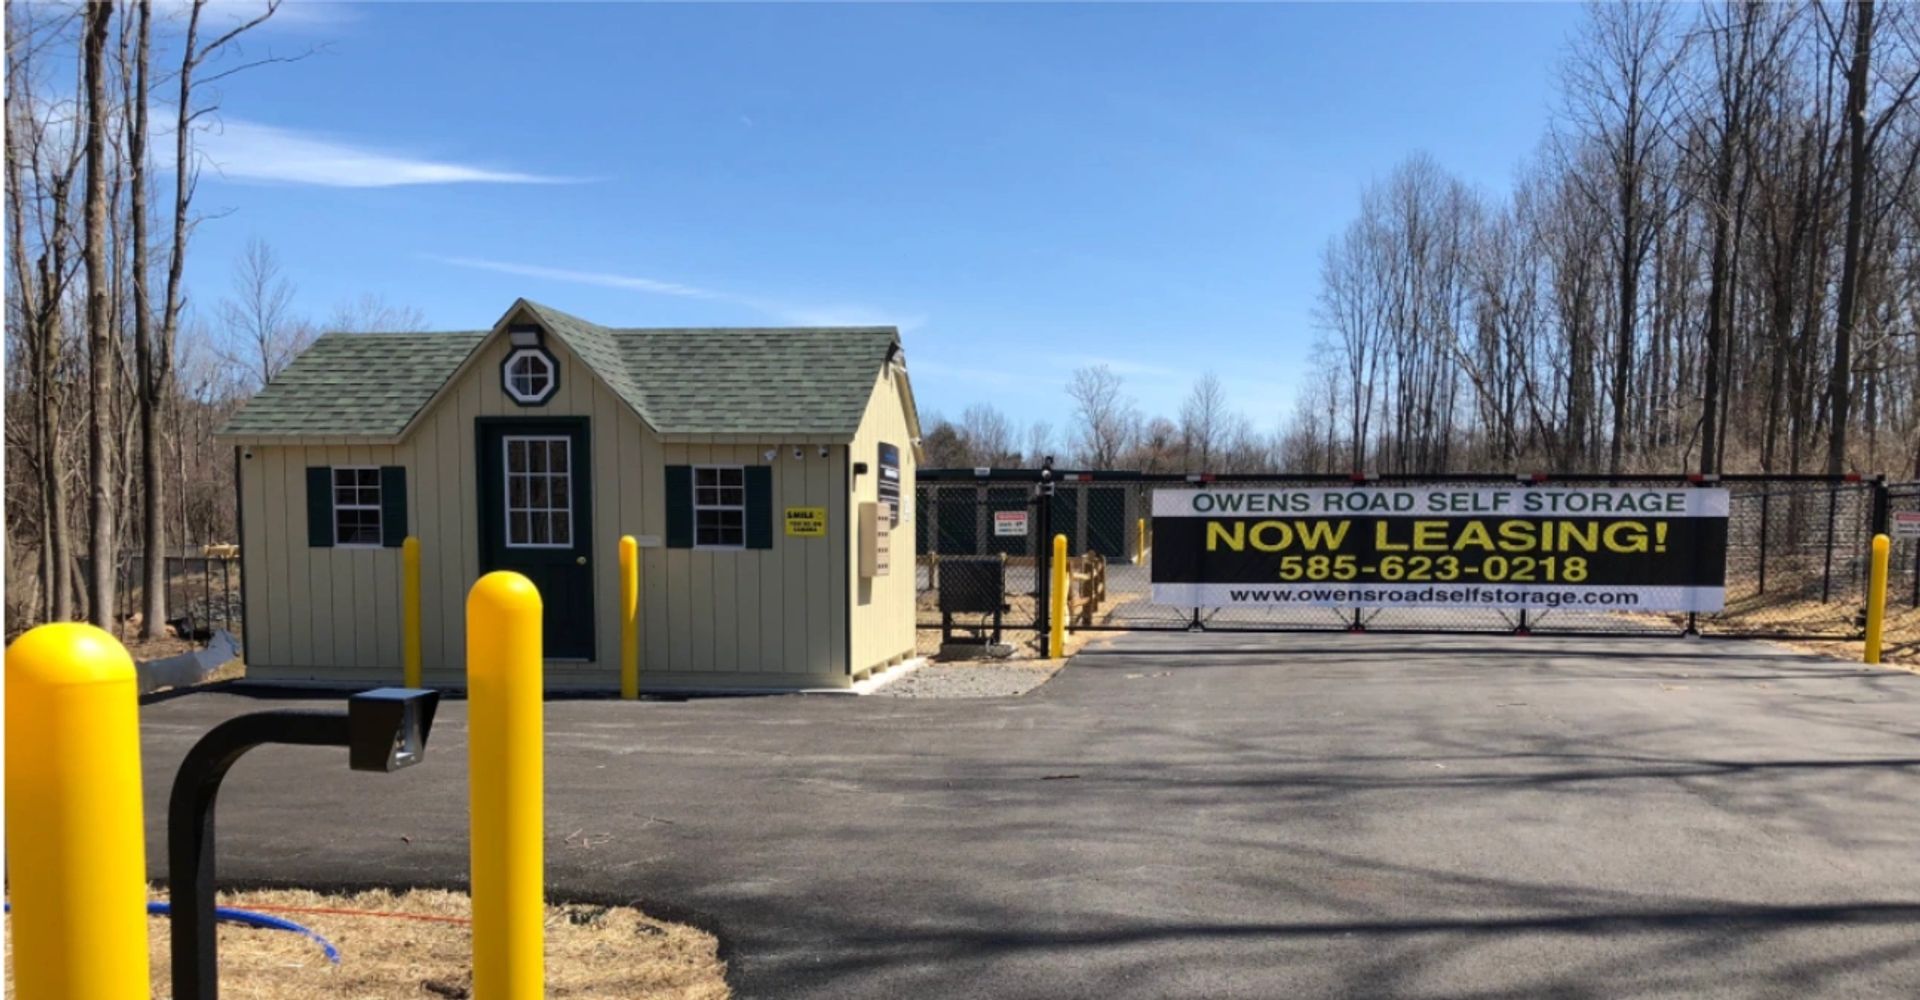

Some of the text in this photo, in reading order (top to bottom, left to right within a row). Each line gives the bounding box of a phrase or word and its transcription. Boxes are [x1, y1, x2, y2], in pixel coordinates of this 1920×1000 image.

[1192, 492, 1686, 512] OWENS ROAD SELF STORAGE
[1206, 520, 1668, 552] NOW LEASING!
[1279, 555, 1588, 582] 585-623-0218
[1229, 587, 1639, 608] www.owensroadselfstorage.com
